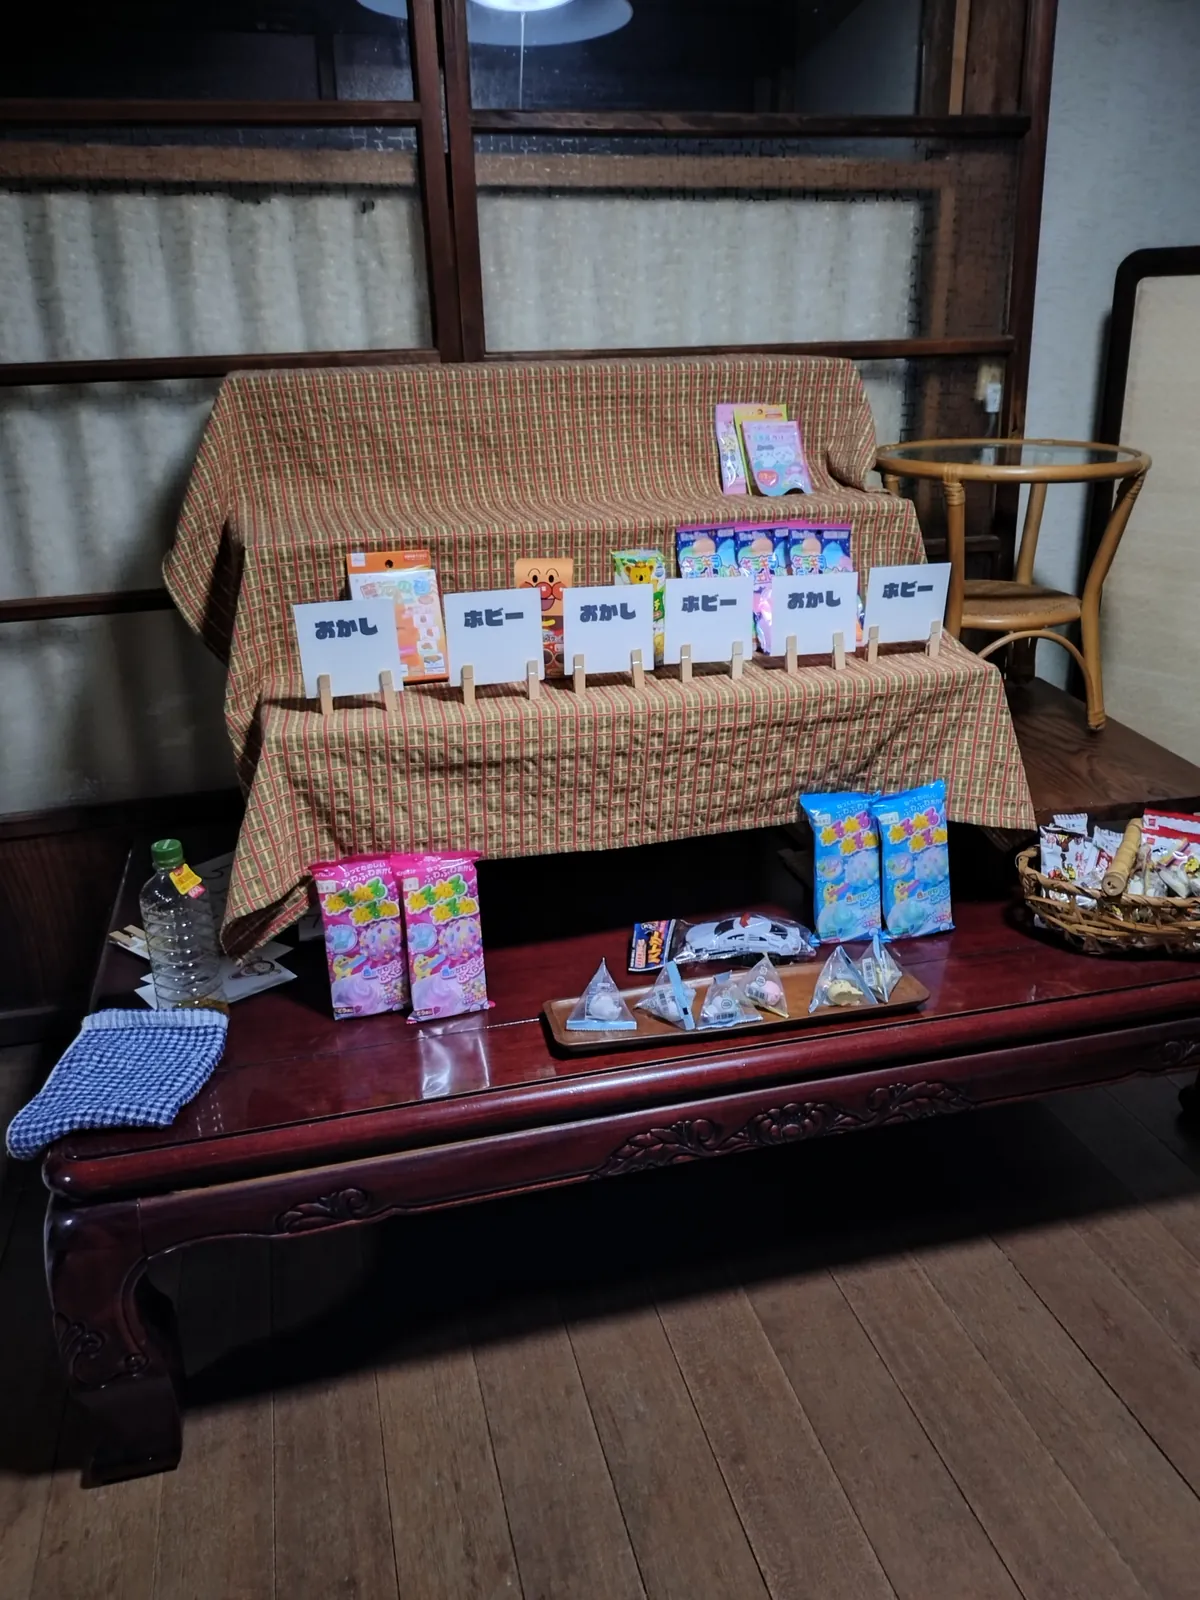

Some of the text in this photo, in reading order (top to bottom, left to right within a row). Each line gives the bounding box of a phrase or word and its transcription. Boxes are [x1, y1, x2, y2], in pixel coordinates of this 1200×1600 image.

[787, 590, 841, 609] おかし
[882, 581, 934, 600] ホビー
[579, 602, 637, 623] おかし
[681, 594, 737, 613] ホビー
[314, 617, 379, 640] おかし
[463, 608, 525, 629] ホビー
